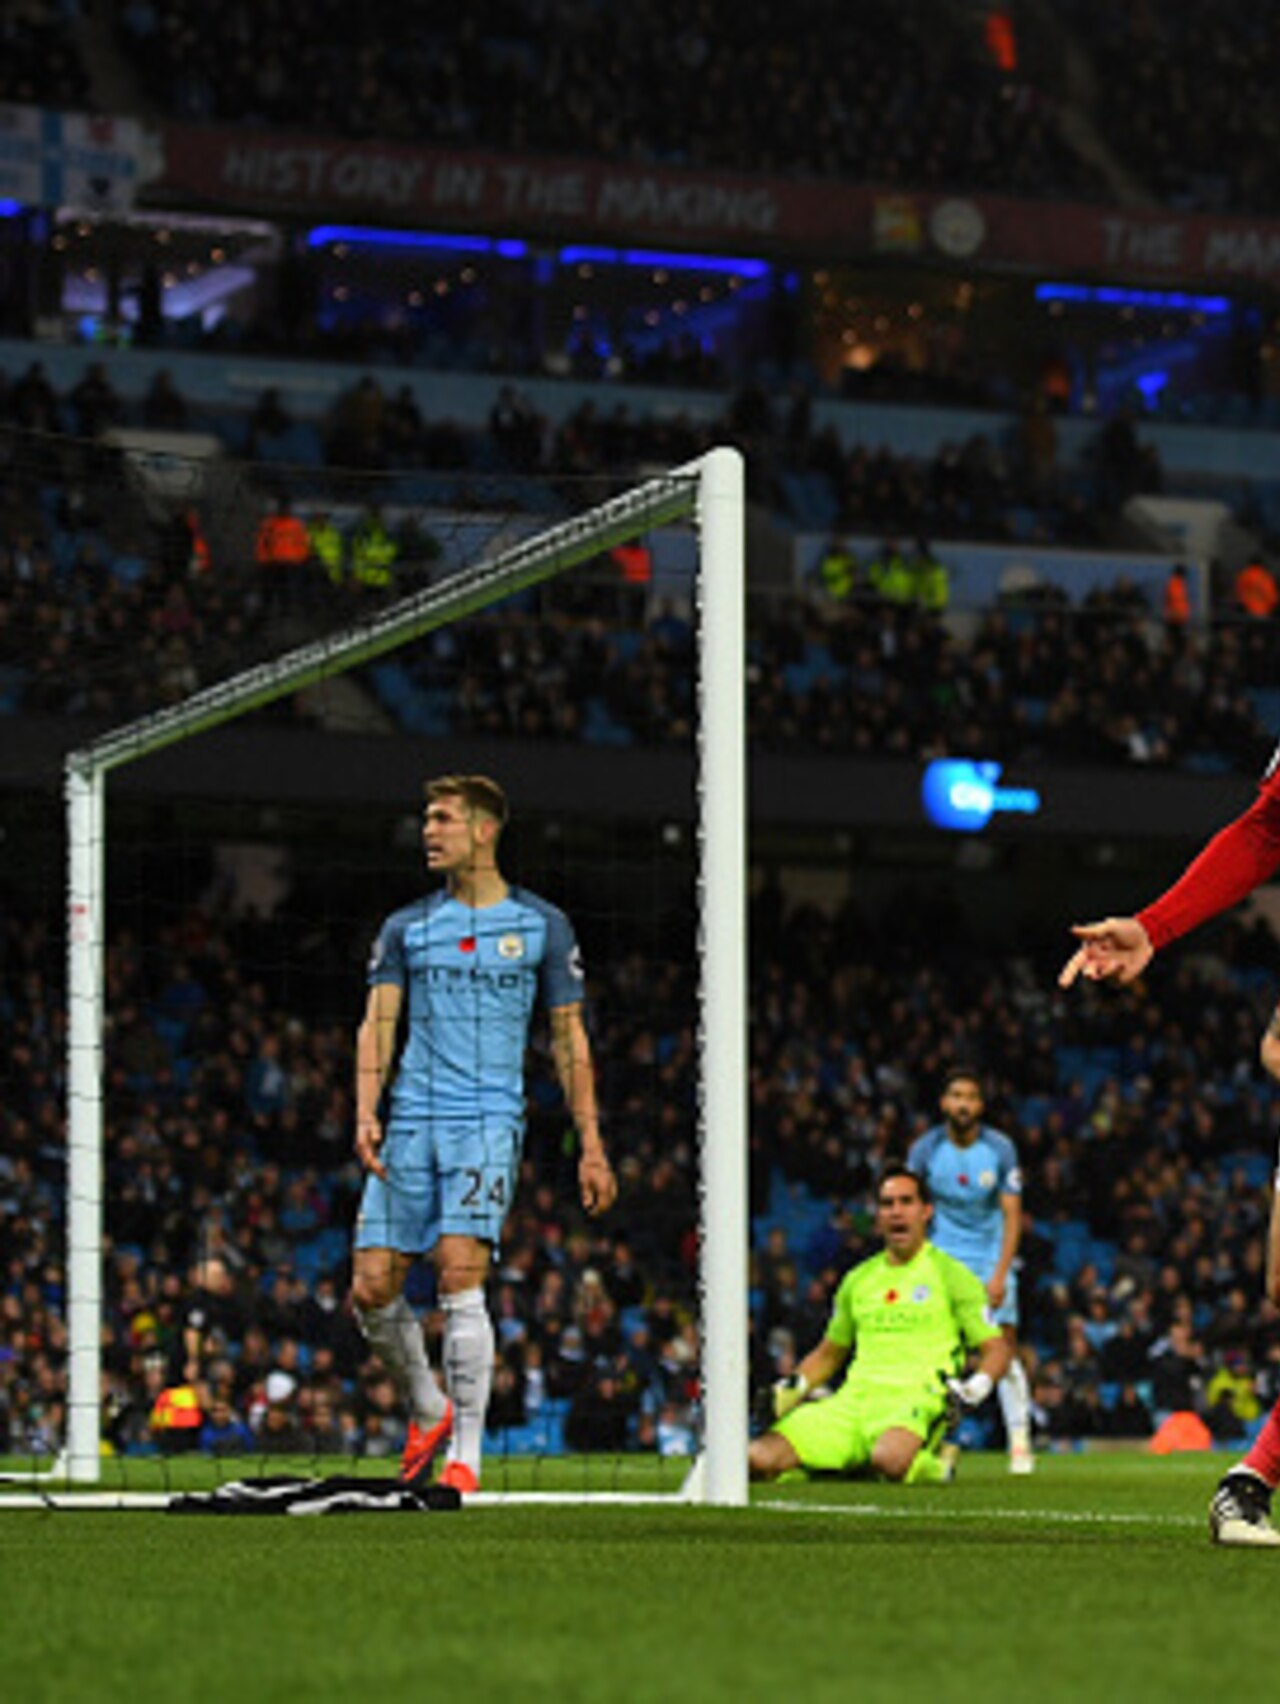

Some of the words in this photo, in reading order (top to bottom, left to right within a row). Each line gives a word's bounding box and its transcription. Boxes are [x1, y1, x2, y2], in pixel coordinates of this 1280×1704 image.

[221, 146, 423, 206] HISTORY
[433, 162, 485, 206] IN
[492, 166, 586, 214] THE
[598, 176, 781, 232] MAKING
[1102, 218, 1182, 266] THE
[460, 1168, 505, 1208] 24
